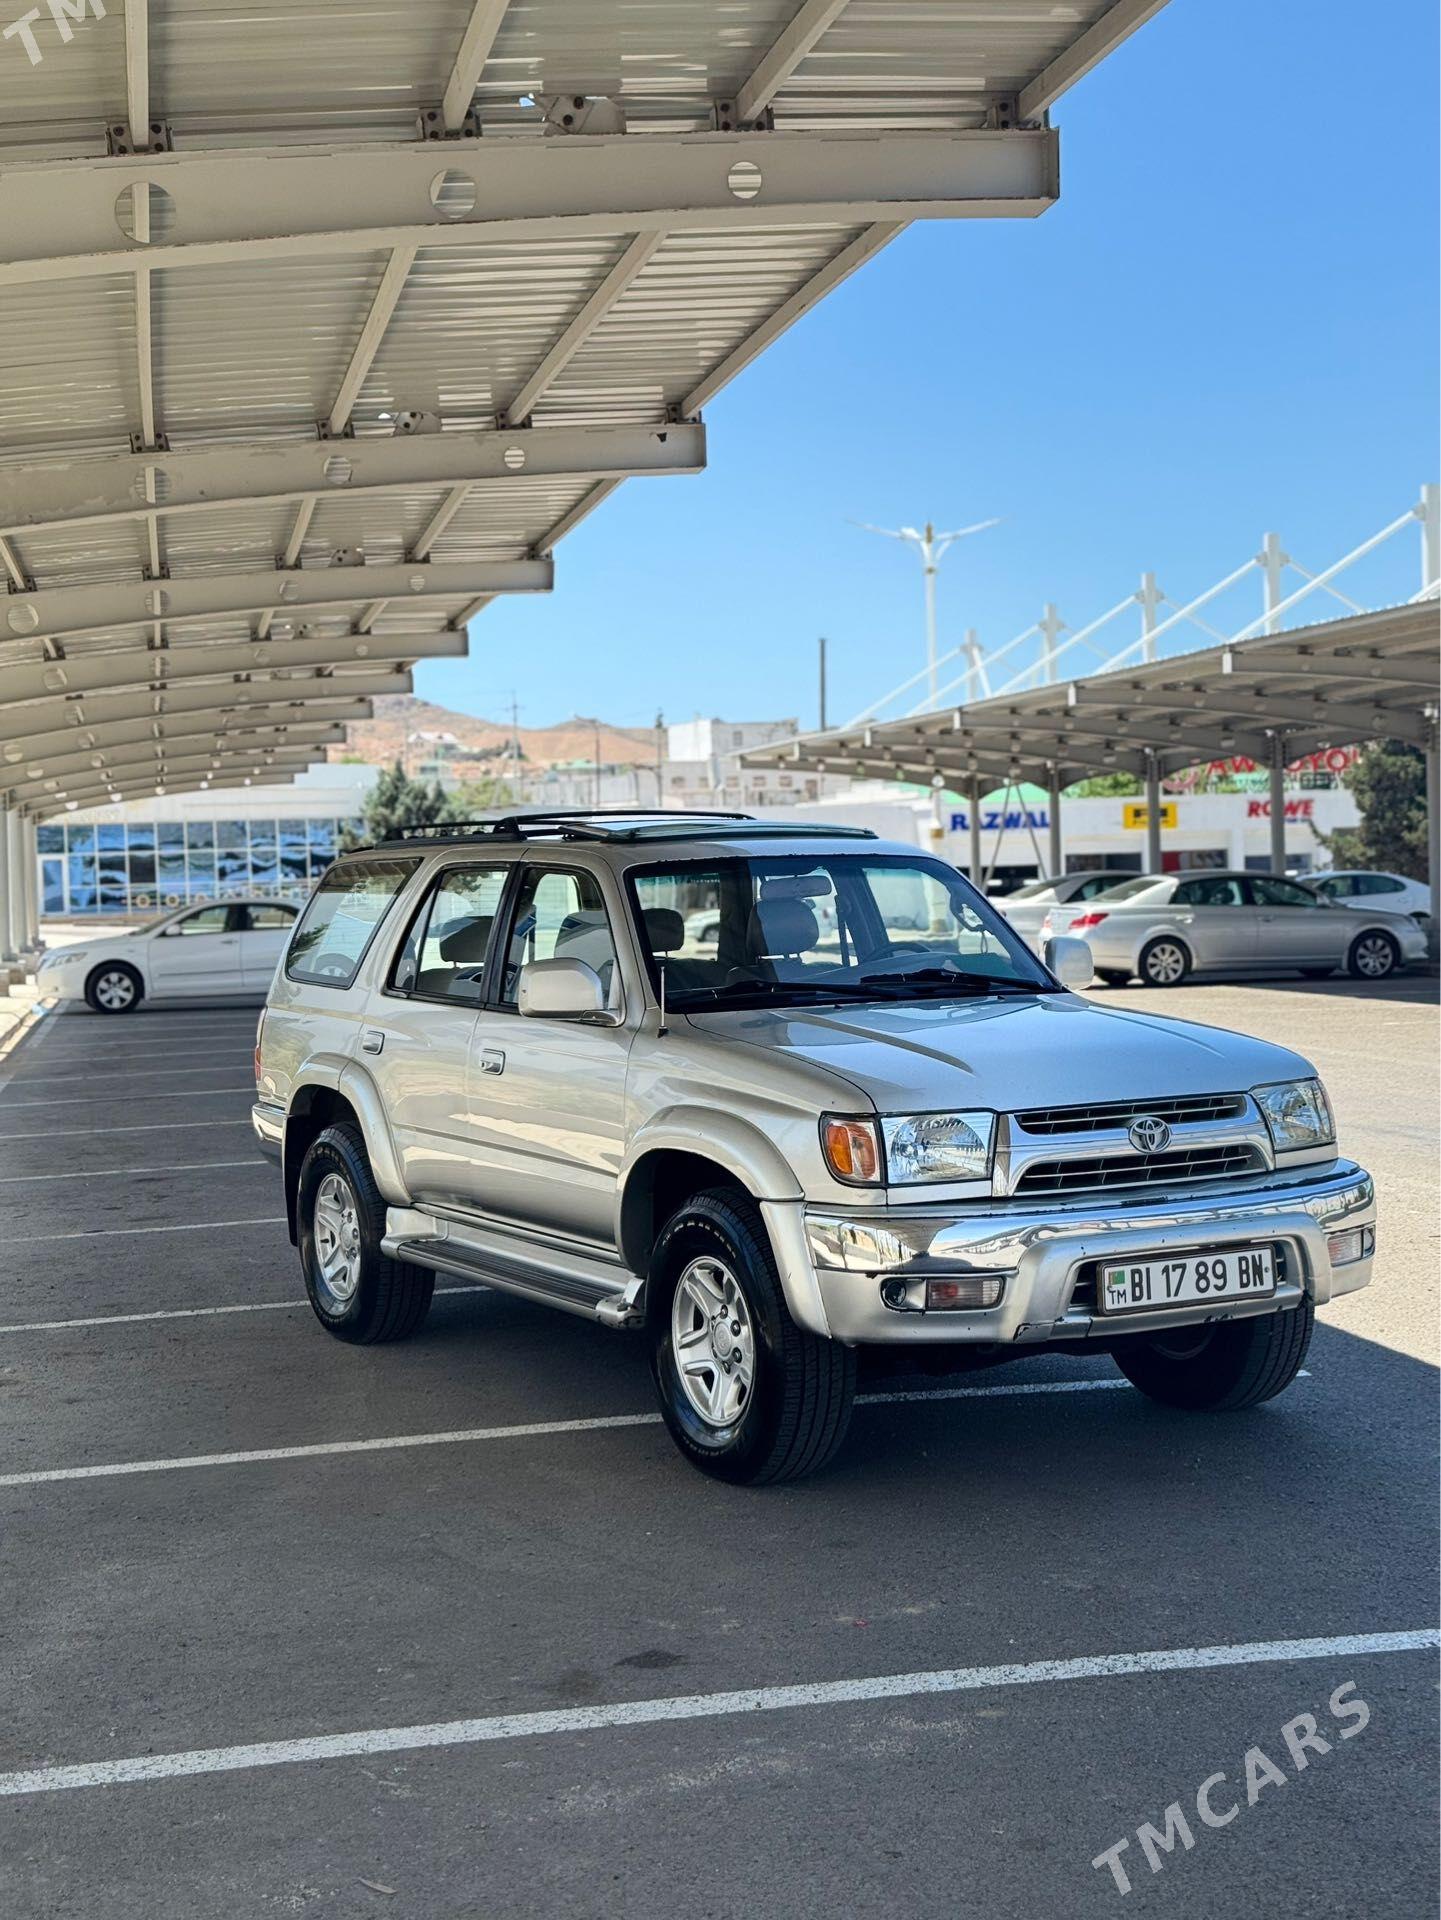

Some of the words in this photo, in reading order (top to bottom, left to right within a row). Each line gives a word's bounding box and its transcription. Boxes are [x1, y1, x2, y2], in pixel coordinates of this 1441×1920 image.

[1130, 1267, 1151, 1302] BI
[1161, 1263, 1187, 1298] 17
[1195, 1259, 1228, 1294] 89
[1238, 1254, 1265, 1289] BN
[1109, 1289, 1127, 1304] TM
